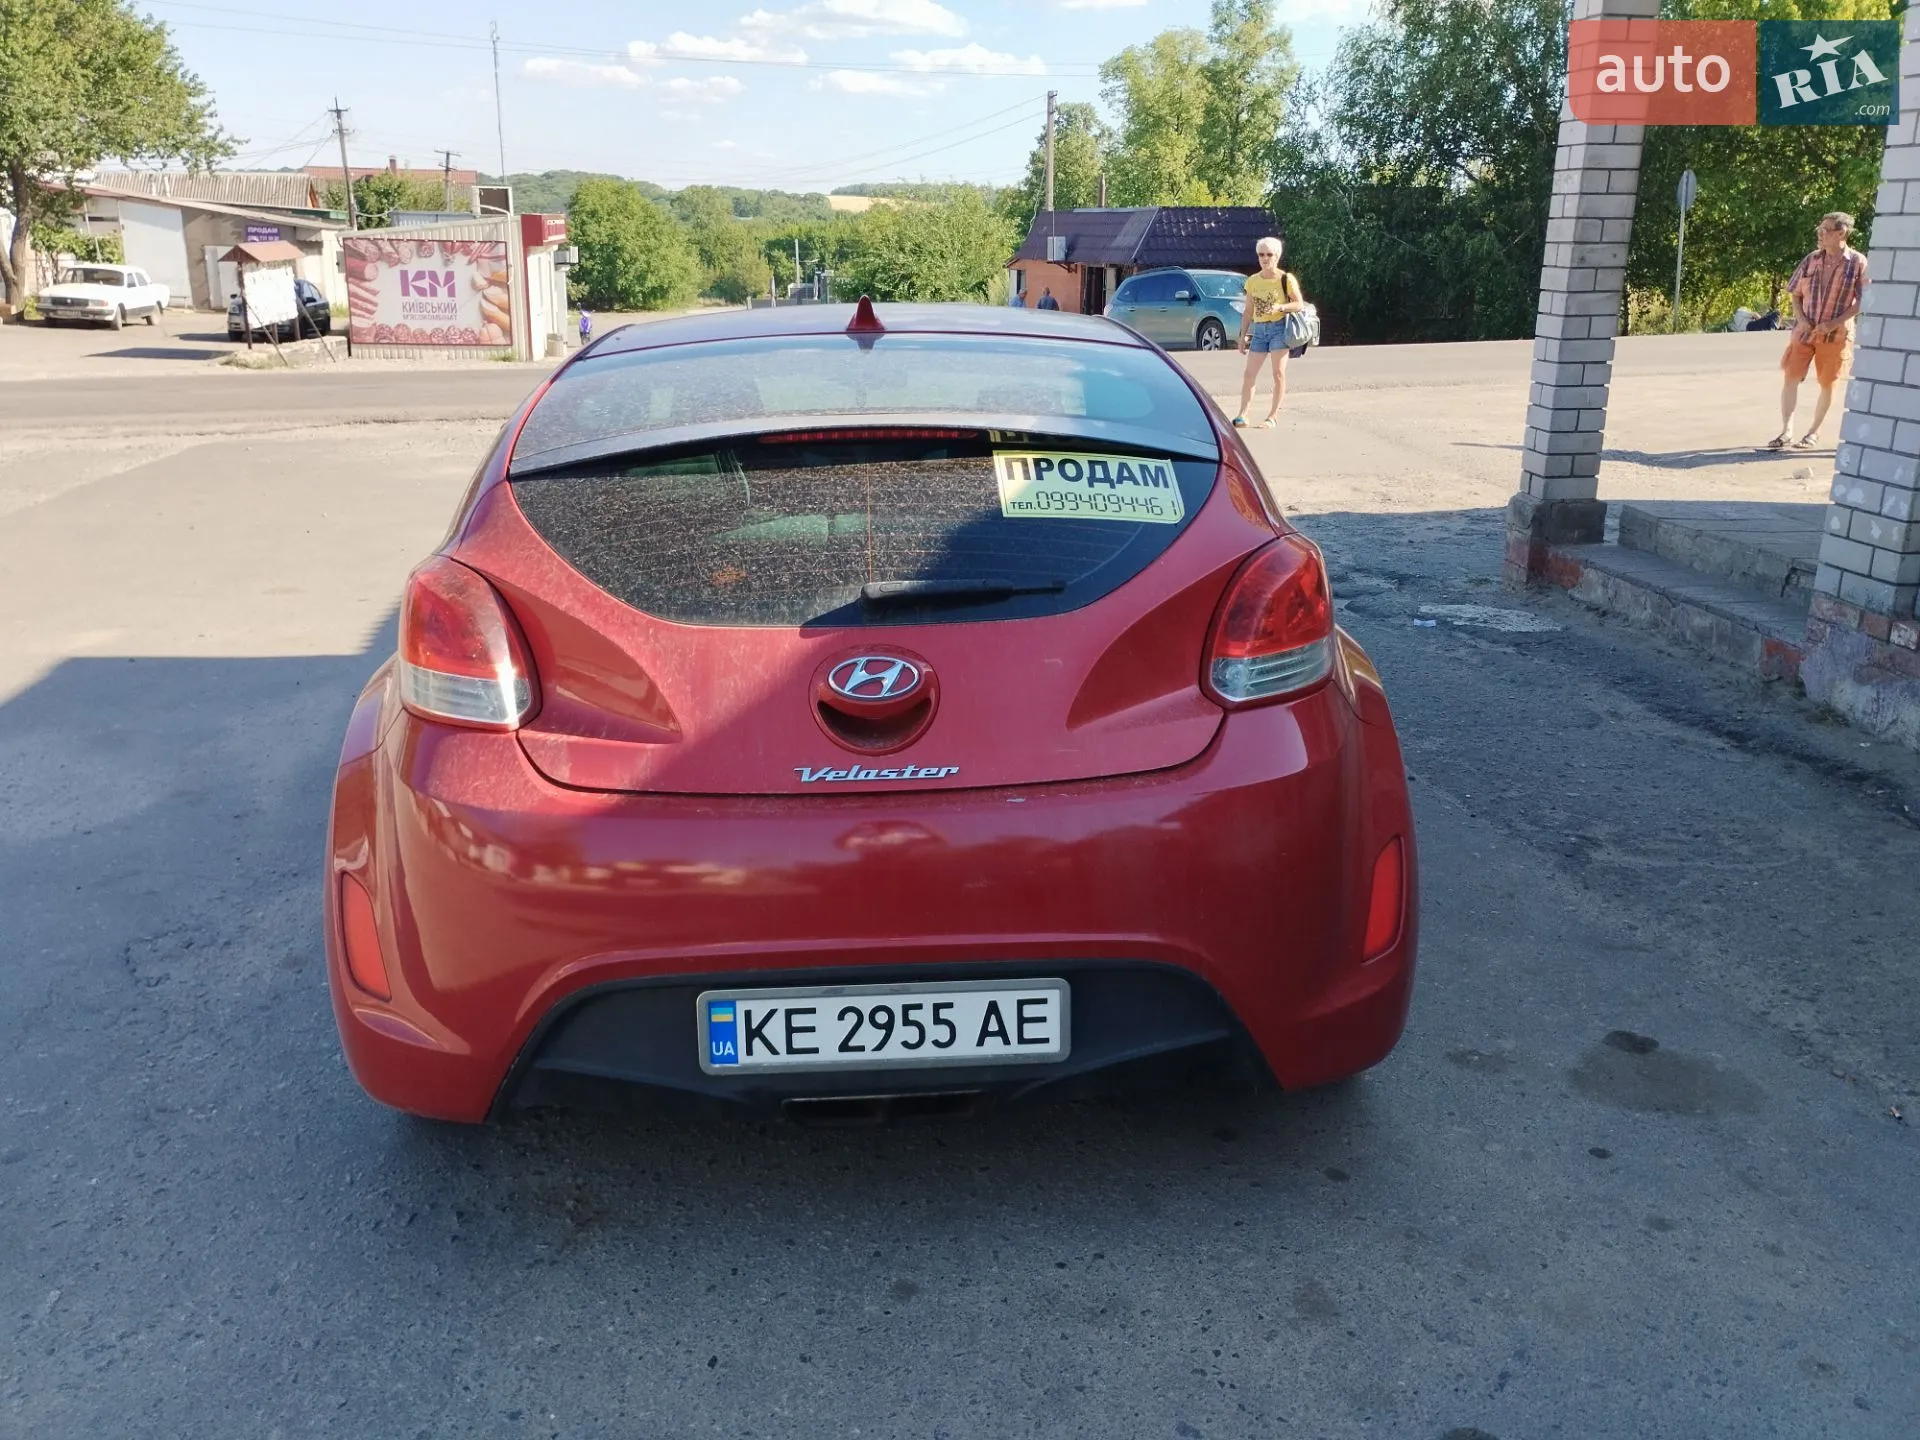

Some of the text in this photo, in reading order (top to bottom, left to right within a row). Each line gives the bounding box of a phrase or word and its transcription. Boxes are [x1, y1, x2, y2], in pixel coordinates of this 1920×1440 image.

[399, 269, 457, 298] КМ
[1003, 457, 1170, 489] ПРОДАМ
[793, 764, 960, 783] Veloster
[743, 997, 1051, 1057] KE 2955 AE
[712, 1040, 735, 1057] UA
